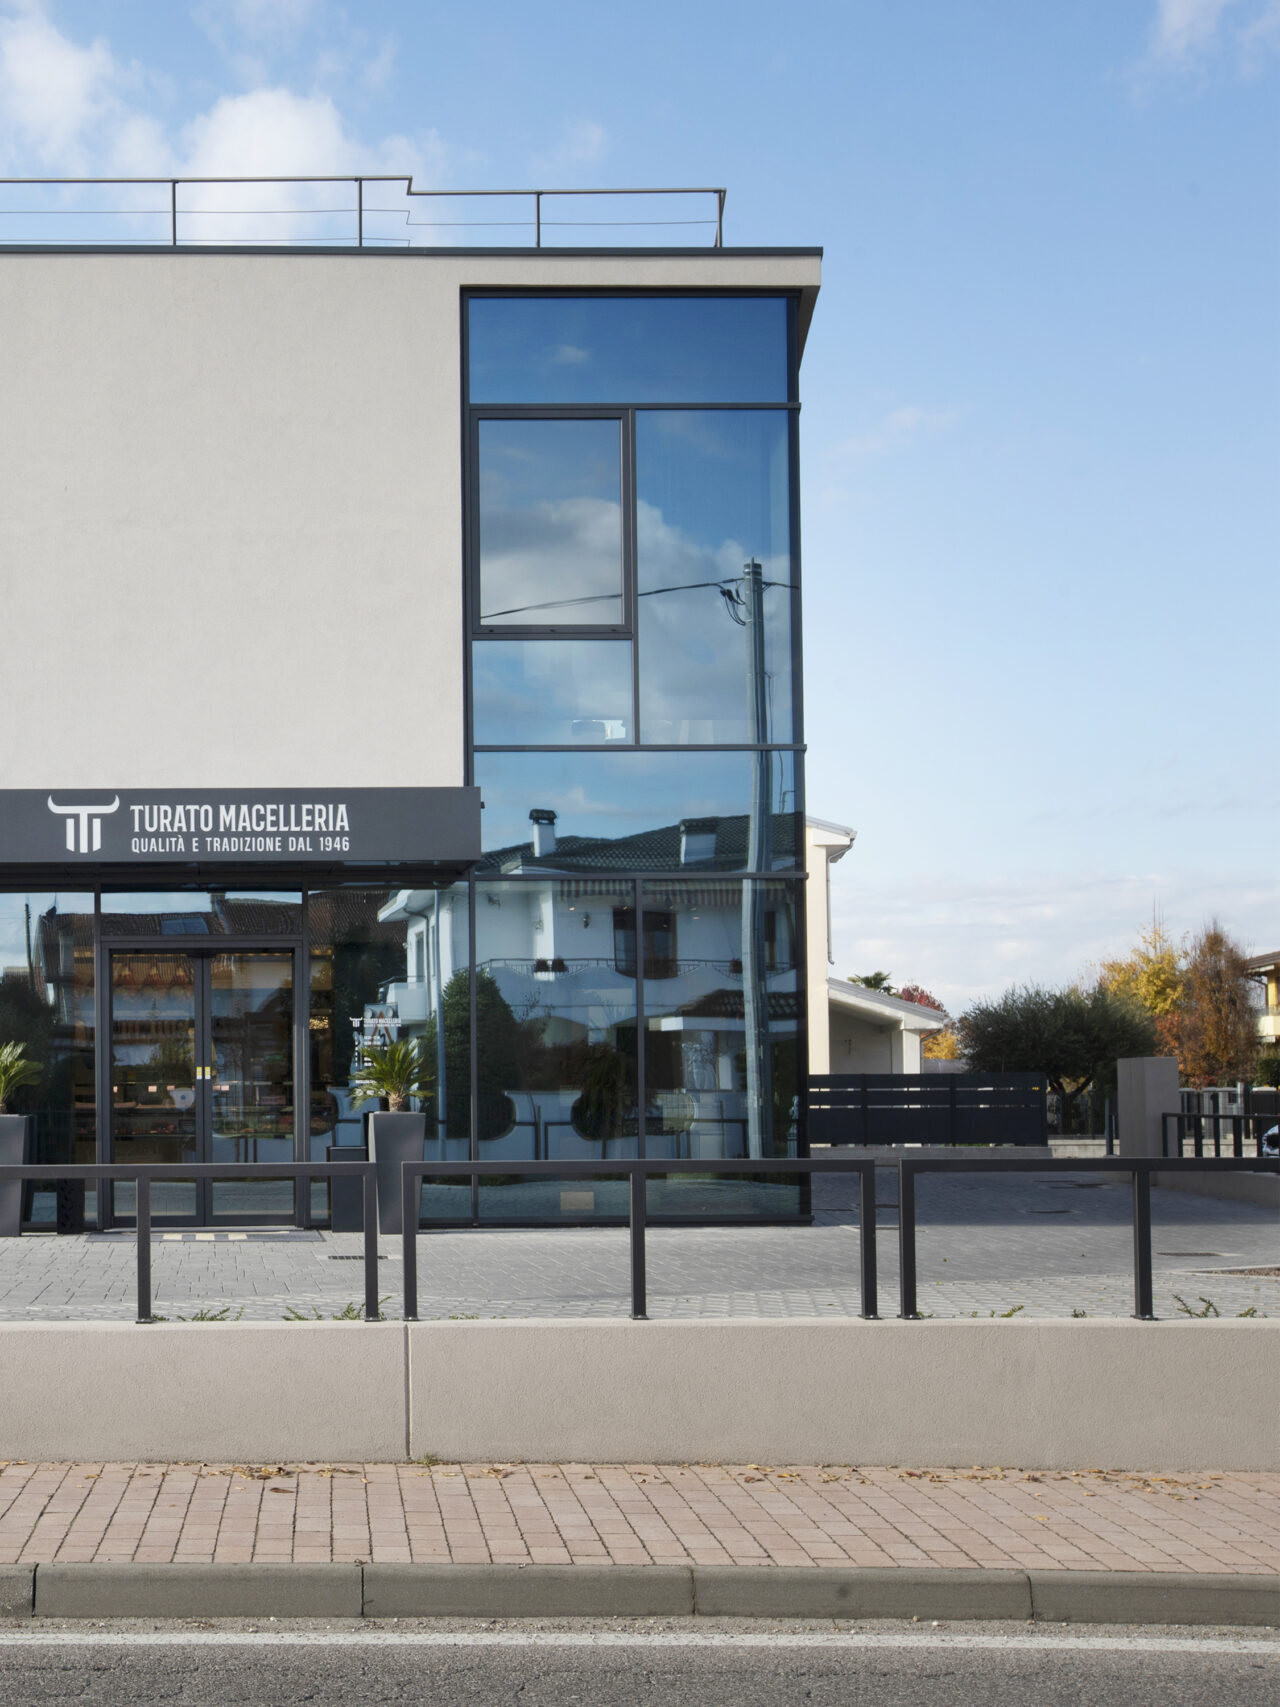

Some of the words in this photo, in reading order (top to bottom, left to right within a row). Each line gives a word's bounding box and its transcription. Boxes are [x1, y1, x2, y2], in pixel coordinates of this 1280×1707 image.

[129, 804, 213, 832] TURATO
[219, 803, 350, 832] MACELLERIA
[131, 835, 185, 854] QUALITÀ
[192, 837, 199, 852] E
[205, 837, 282, 852] TRADIZIONE
[288, 836, 313, 852] DAL
[319, 836, 350, 852] 1946
